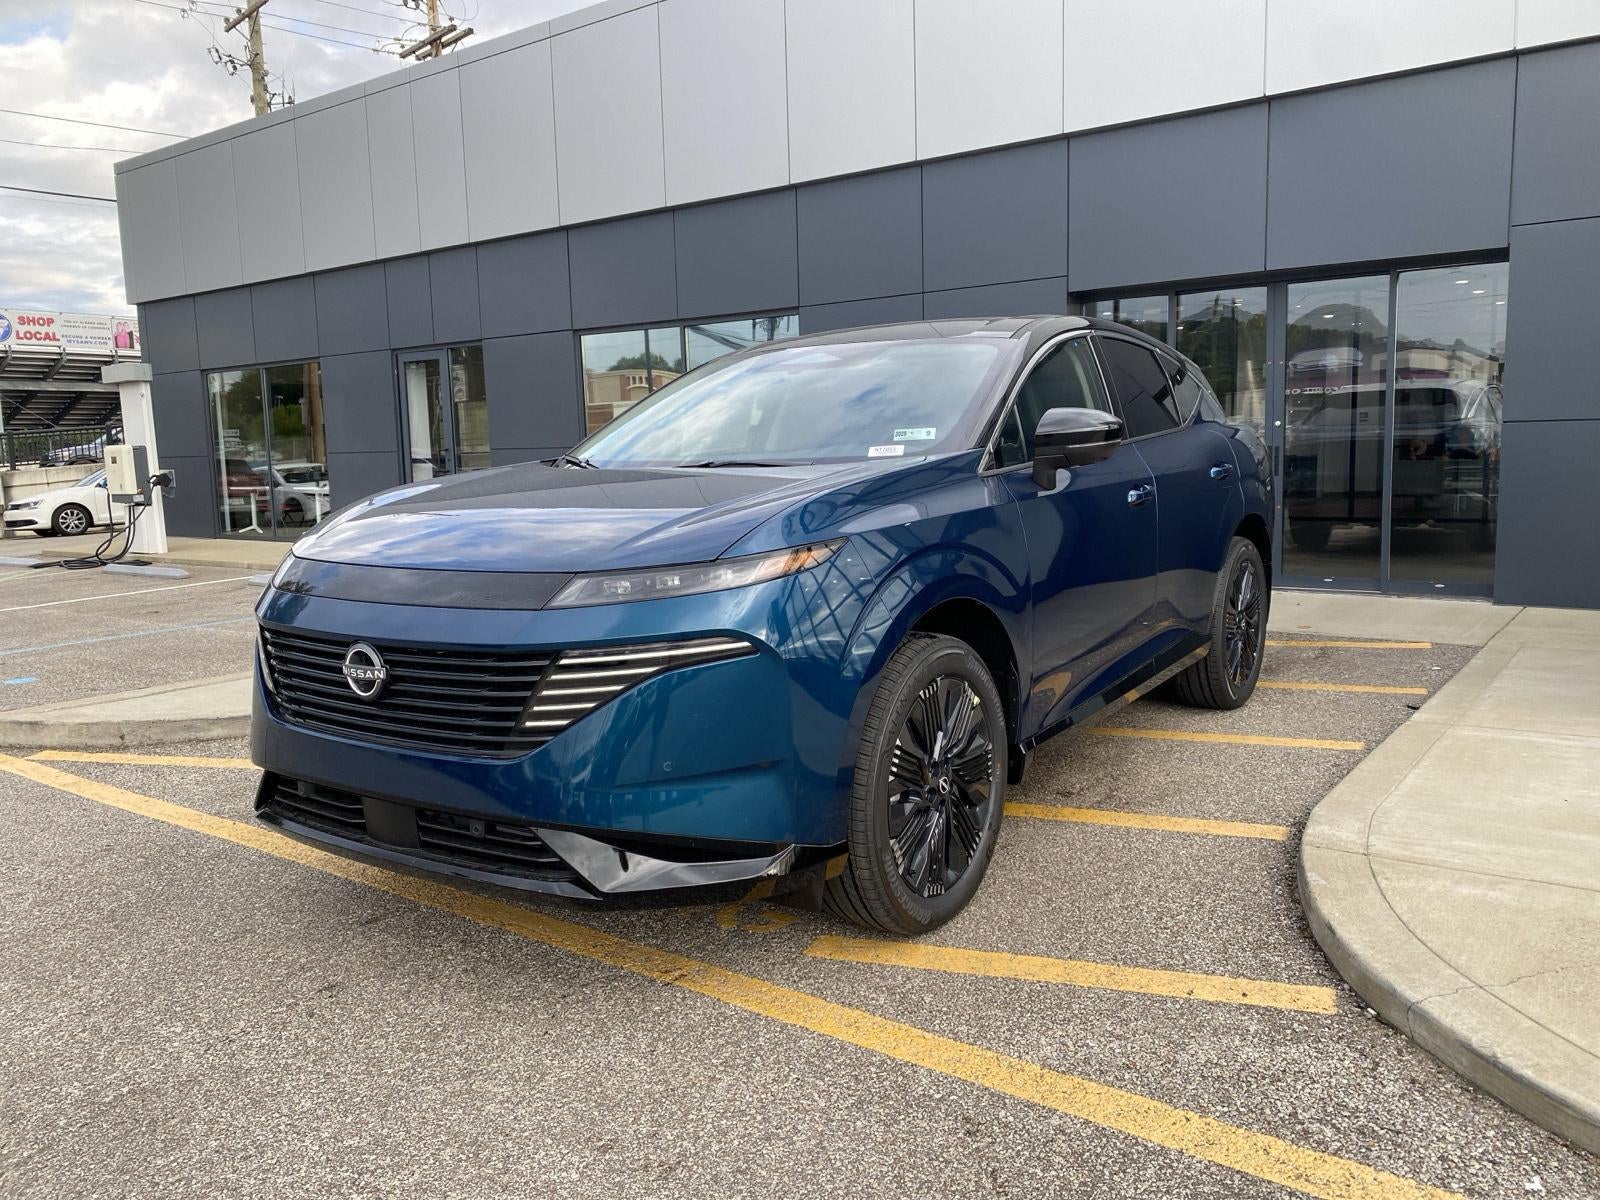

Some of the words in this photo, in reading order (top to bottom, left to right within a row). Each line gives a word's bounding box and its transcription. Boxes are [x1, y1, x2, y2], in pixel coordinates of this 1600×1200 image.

[17, 315, 55, 327] SHOP
[15, 329, 60, 342] LOCAL
[342, 665, 384, 679] NISSAN
